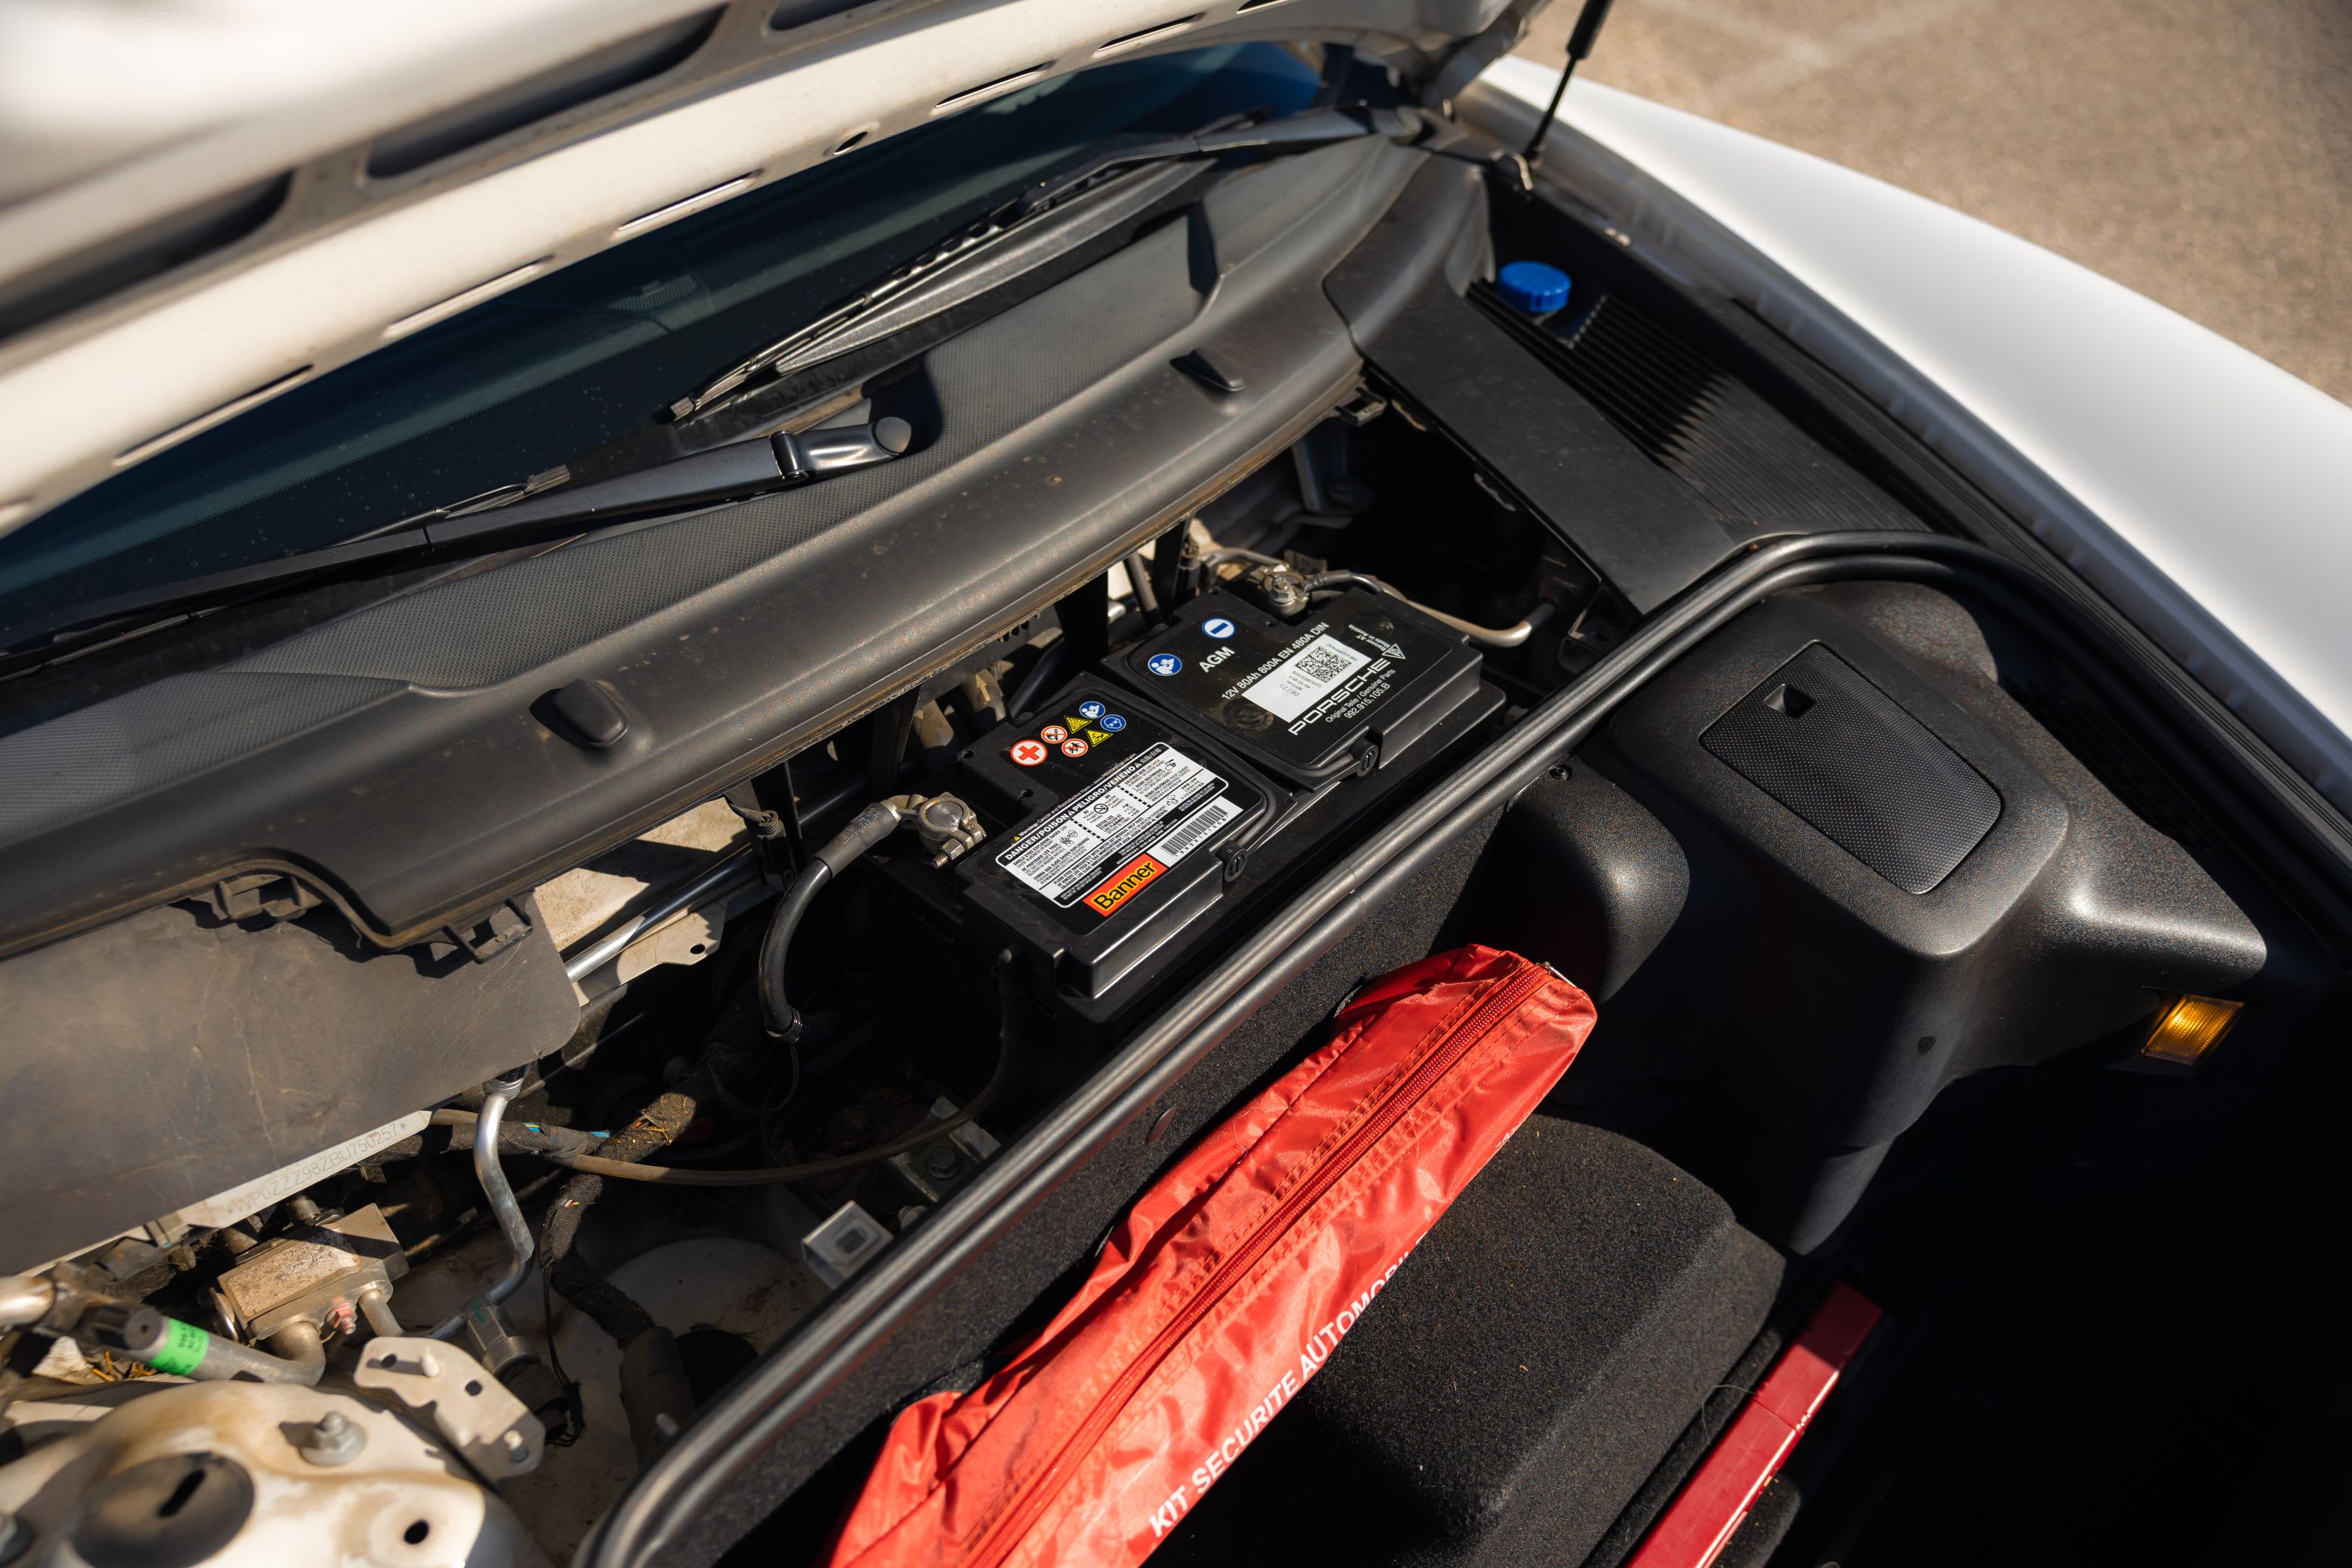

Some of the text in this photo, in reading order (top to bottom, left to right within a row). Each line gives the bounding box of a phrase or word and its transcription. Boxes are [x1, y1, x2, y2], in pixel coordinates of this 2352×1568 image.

[1199, 646, 1235, 673] AGM
[1221, 622, 1330, 700] 12V 80Ah 800A EN 480A DIN
[1288, 658, 1391, 735] PORSCHE
[1325, 706, 1348, 722] Original
[1344, 698, 1359, 708] Teile
[1359, 678, 1382, 697] Genuine
[1379, 669, 1396, 680] Parts
[1344, 682, 1391, 719] 992.915.105.B
[1004, 813, 1070, 860] DANGER/POISON
[1072, 765, 1137, 811] PELIGRO/VENENO
[1093, 861, 1156, 910] Banner
[1149, 1486, 1189, 1537] KIT
[1192, 1370, 1299, 1494] SECURITE
